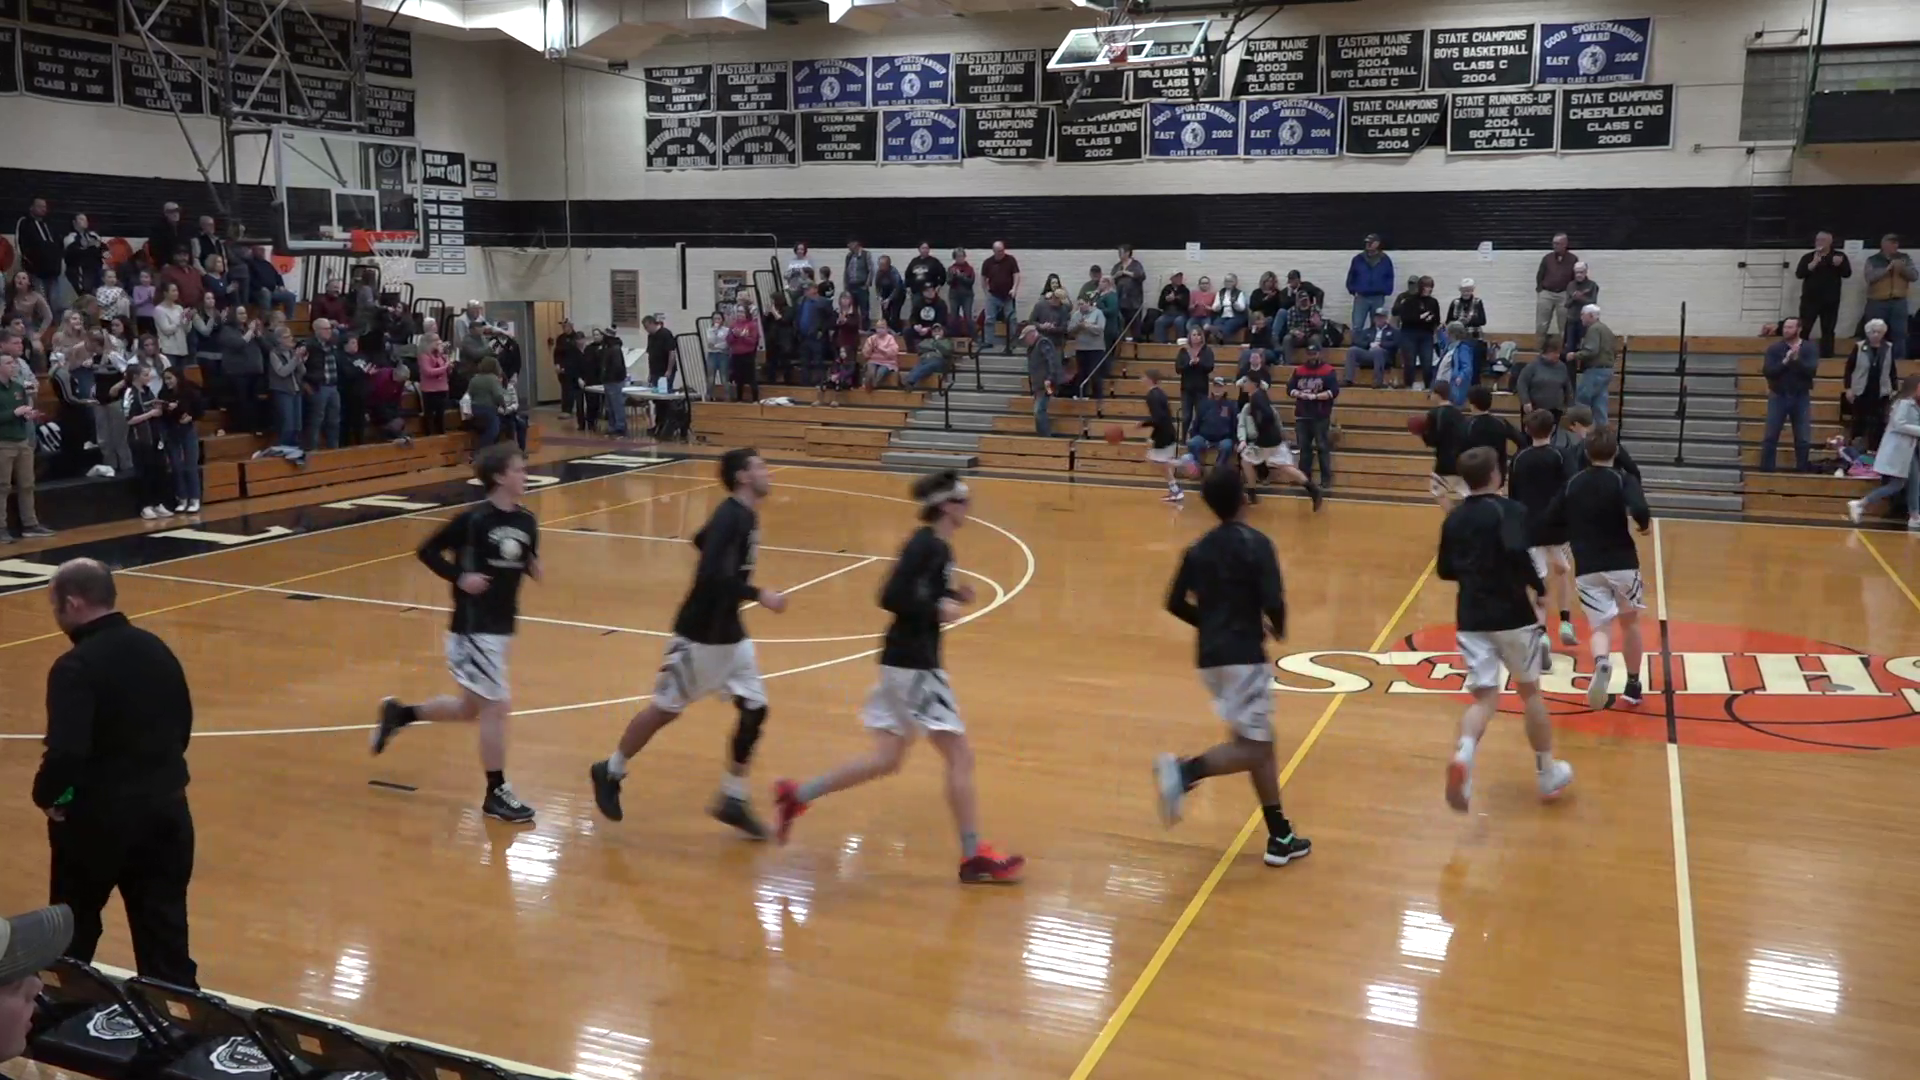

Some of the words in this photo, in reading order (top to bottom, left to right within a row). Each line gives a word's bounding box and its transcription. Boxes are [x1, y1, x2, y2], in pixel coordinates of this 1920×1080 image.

[1437, 33, 1468, 44] STATE
[1472, 30, 1527, 41] CHAMPIONS
[1544, 30, 1567, 49] GOOD
[1572, 22, 1644, 44] SPORTSMANSHIP
[1579, 32, 1610, 42] AWARD
[1249, 40, 1277, 51] STERN
[1281, 39, 1309, 50] MAINE
[1338, 37, 1380, 48] EASTERN
[1383, 34, 1412, 45] MAINE
[1341, 45, 1408, 59] CHAMPIONS
[1434, 47, 1459, 58] BOYS
[1463, 44, 1528, 57] BASKETBALL
[956, 52, 1000, 65] EASTERN
[1003, 51, 1036, 63] MAINE
[1253, 51, 1303, 63] AMPIONS
[1546, 56, 1570, 66] EAST
[1357, 58, 1390, 67] 2004
[1453, 61, 1494, 71] CLASS
[1499, 60, 1508, 69] C
[38, 61, 64, 75] BOYS
[74, 66, 99, 79] GOLF
[717, 63, 756, 75] EASTERN
[760, 62, 787, 73] MAINE
[968, 63, 1025, 76] CHAMPIONS
[1256, 64, 1287, 72] 2003
[1331, 69, 1353, 78] BOYS
[1357, 67, 1417, 77] BASKETBALL
[727, 73, 776, 85] CHAMPIONS
[1138, 70, 1160, 78] GIRLS
[1269, 73, 1303, 82] SOCCER
[1462, 74, 1497, 83] 2004
[1567, 75, 1587, 83] CLASS
[34, 77, 66, 92] CLASS
[877, 82, 894, 91] EAST
[1153, 79, 1188, 88] CLASS
[1249, 83, 1284, 92] CLASS
[1287, 83, 1295, 91] C
[1348, 79, 1386, 88] CLASS
[1390, 78, 1398, 86] C
[798, 86, 814, 94] EAST
[969, 84, 1023, 94] CHEERLEADING
[979, 94, 1001, 102] CLASS
[1455, 95, 1484, 107] STATE
[1489, 93, 1551, 106] RUNNERS-UP
[1571, 93, 1604, 105] STATE
[1609, 90, 1664, 102] CHAMPIONS
[738, 102, 757, 110] CLASS
[1353, 100, 1381, 111] STATE
[1386, 98, 1438, 110] CHAMPIONS
[976, 109, 1012, 120] EASTERN
[1015, 108, 1038, 118] MAINE
[1152, 109, 1172, 127] GOOD
[1175, 103, 1236, 124] SPORTSMANSHIP
[1250, 105, 1269, 122] GOOD
[1272, 99, 1335, 120] SPORTSMANSHIP
[1280, 108, 1306, 117] AWARD
[1454, 108, 1485, 119] EASTERN
[1489, 107, 1510, 118] MAINE
[1514, 105, 1552, 116] CHAMPIONS
[1569, 105, 1664, 119] CHEERLEADING
[813, 115, 843, 123] EASTERN
[1181, 113, 1207, 122] AWARD
[1351, 113, 1440, 126] CHEERLEADING
[1485, 118, 1519, 127] 2004
[821, 124, 857, 133] CHAMPIONS
[978, 120, 1034, 130] CHAMPIONS
[1061, 122, 1138, 135] CHEERLEADING
[1587, 121, 1629, 131] CLASS
[1634, 120, 1644, 130] C
[994, 131, 1018, 139] 2001
[1155, 131, 1175, 140] EAST
[1211, 130, 1233, 138] 2002
[1250, 130, 1271, 138] EAST
[1310, 129, 1331, 137] 2004
[1368, 127, 1407, 138] CLASS
[1412, 127, 1420, 136] C
[1469, 129, 1534, 139] SOFTBALL
[888, 138, 905, 146] EAST
[978, 139, 1033, 148] CHEERLEADING
[1075, 137, 1110, 146] CLASS
[1377, 140, 1409, 149] 2004
[1475, 139, 1514, 148] CLASS
[1519, 138, 1527, 147] C
[824, 152, 845, 160] CLASS
[1085, 148, 1113, 157] 2002
[1196, 148, 1218, 156] HOCKEY
